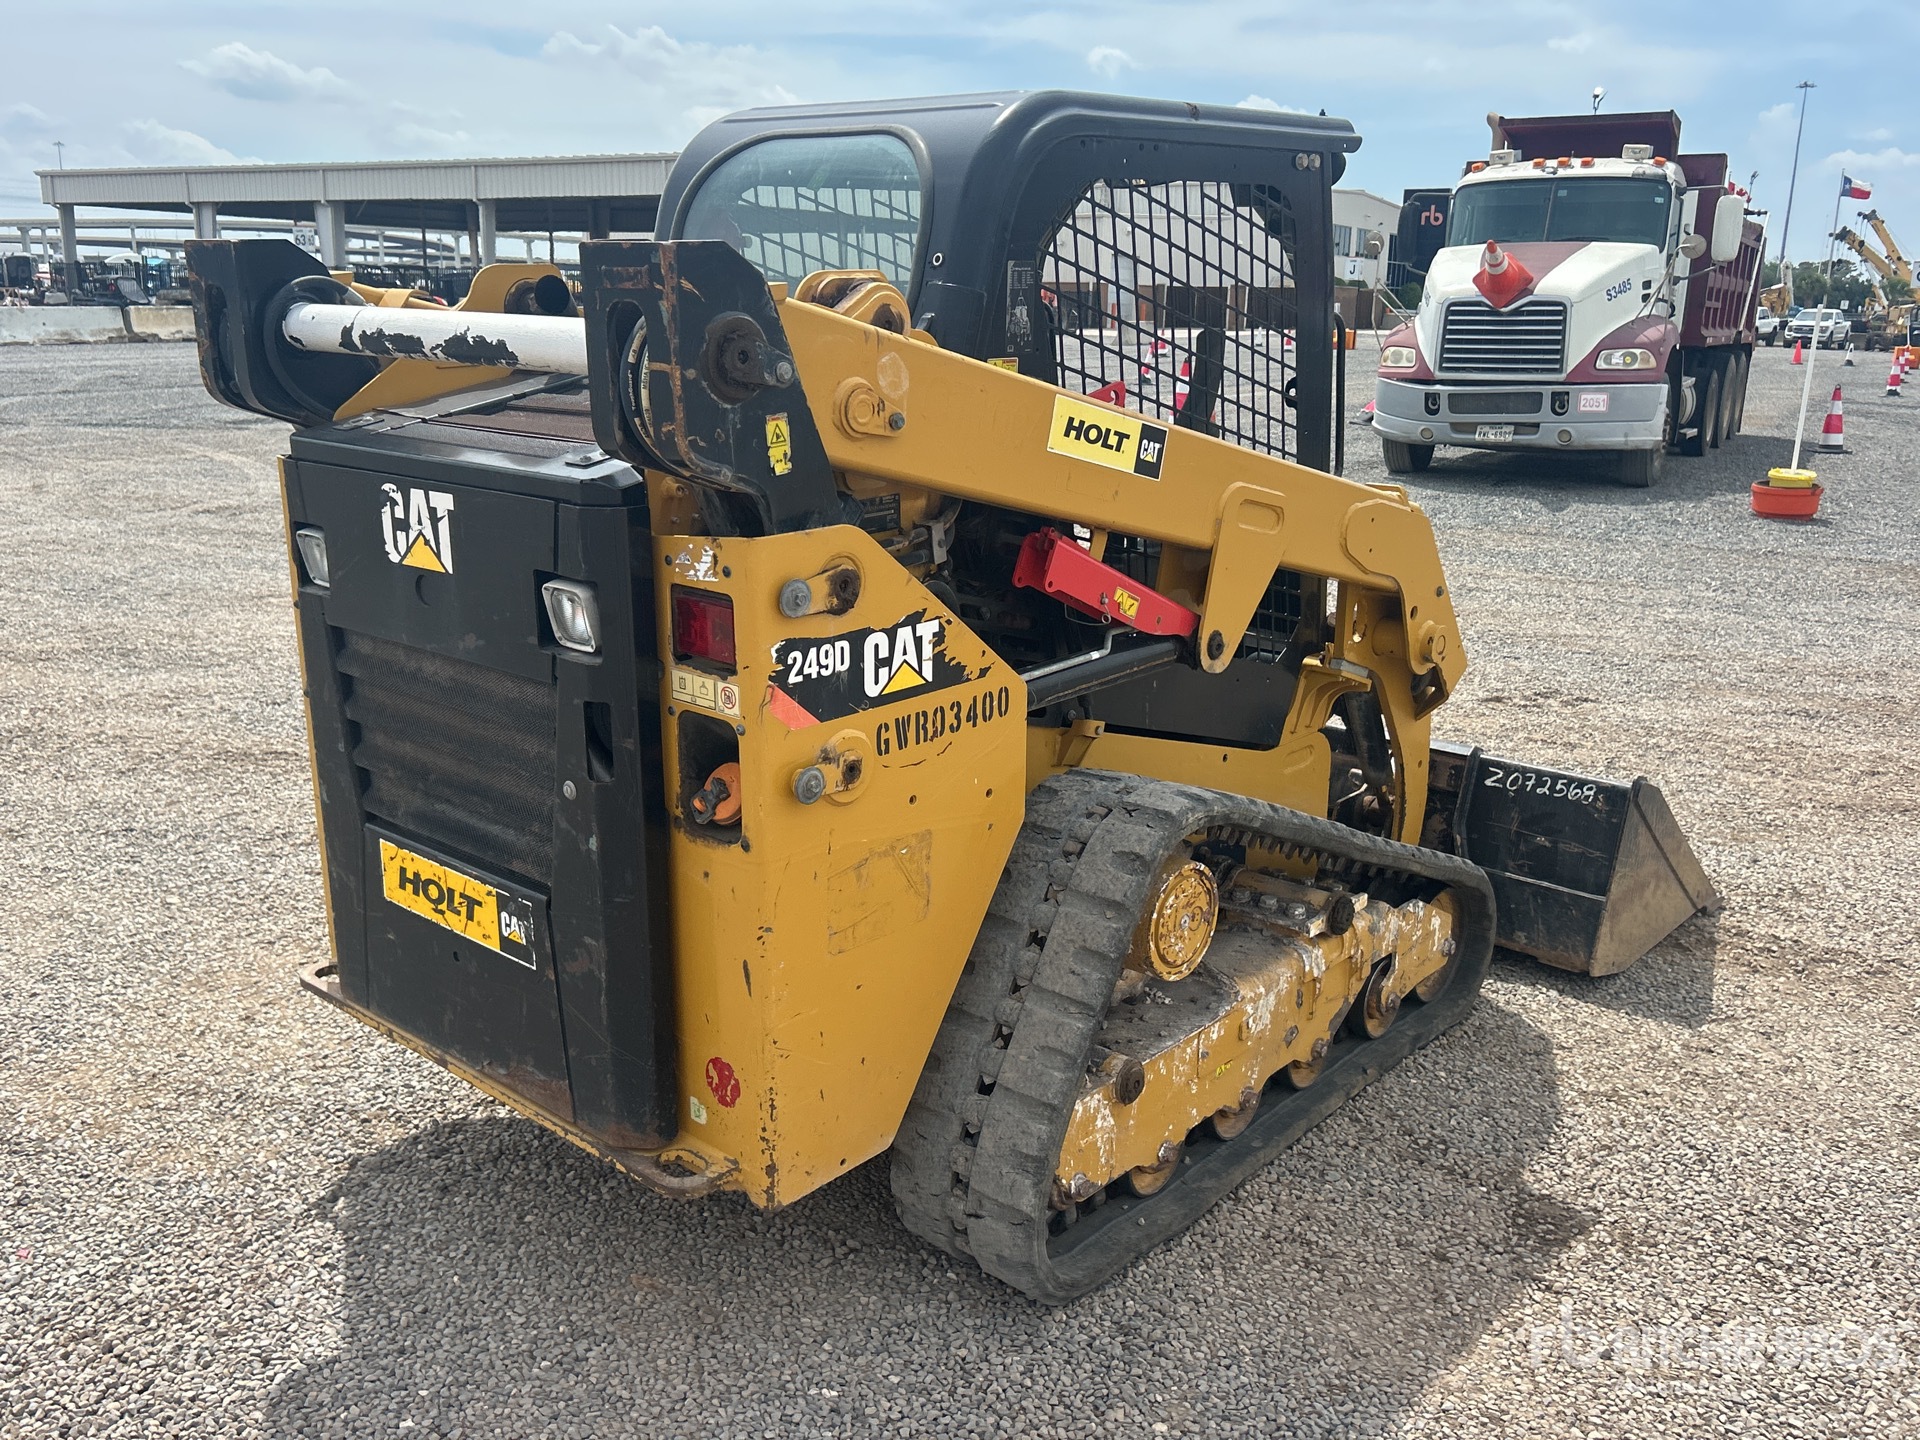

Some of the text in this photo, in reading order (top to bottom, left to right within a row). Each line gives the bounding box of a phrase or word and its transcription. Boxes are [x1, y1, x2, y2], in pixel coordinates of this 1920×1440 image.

[1421, 204, 1444, 226] rb
[295, 234, 306, 246] 63
[1349, 264, 1356, 275] J
[1605, 277, 1632, 302] S3485
[1581, 397, 1606, 408] 2051
[1063, 415, 1162, 464] HOLT CAT
[381, 483, 454, 574] CAT
[786, 619, 940, 698] 249D CAT
[876, 685, 1010, 757] GWR03400
[398, 865, 483, 922] HOLT
